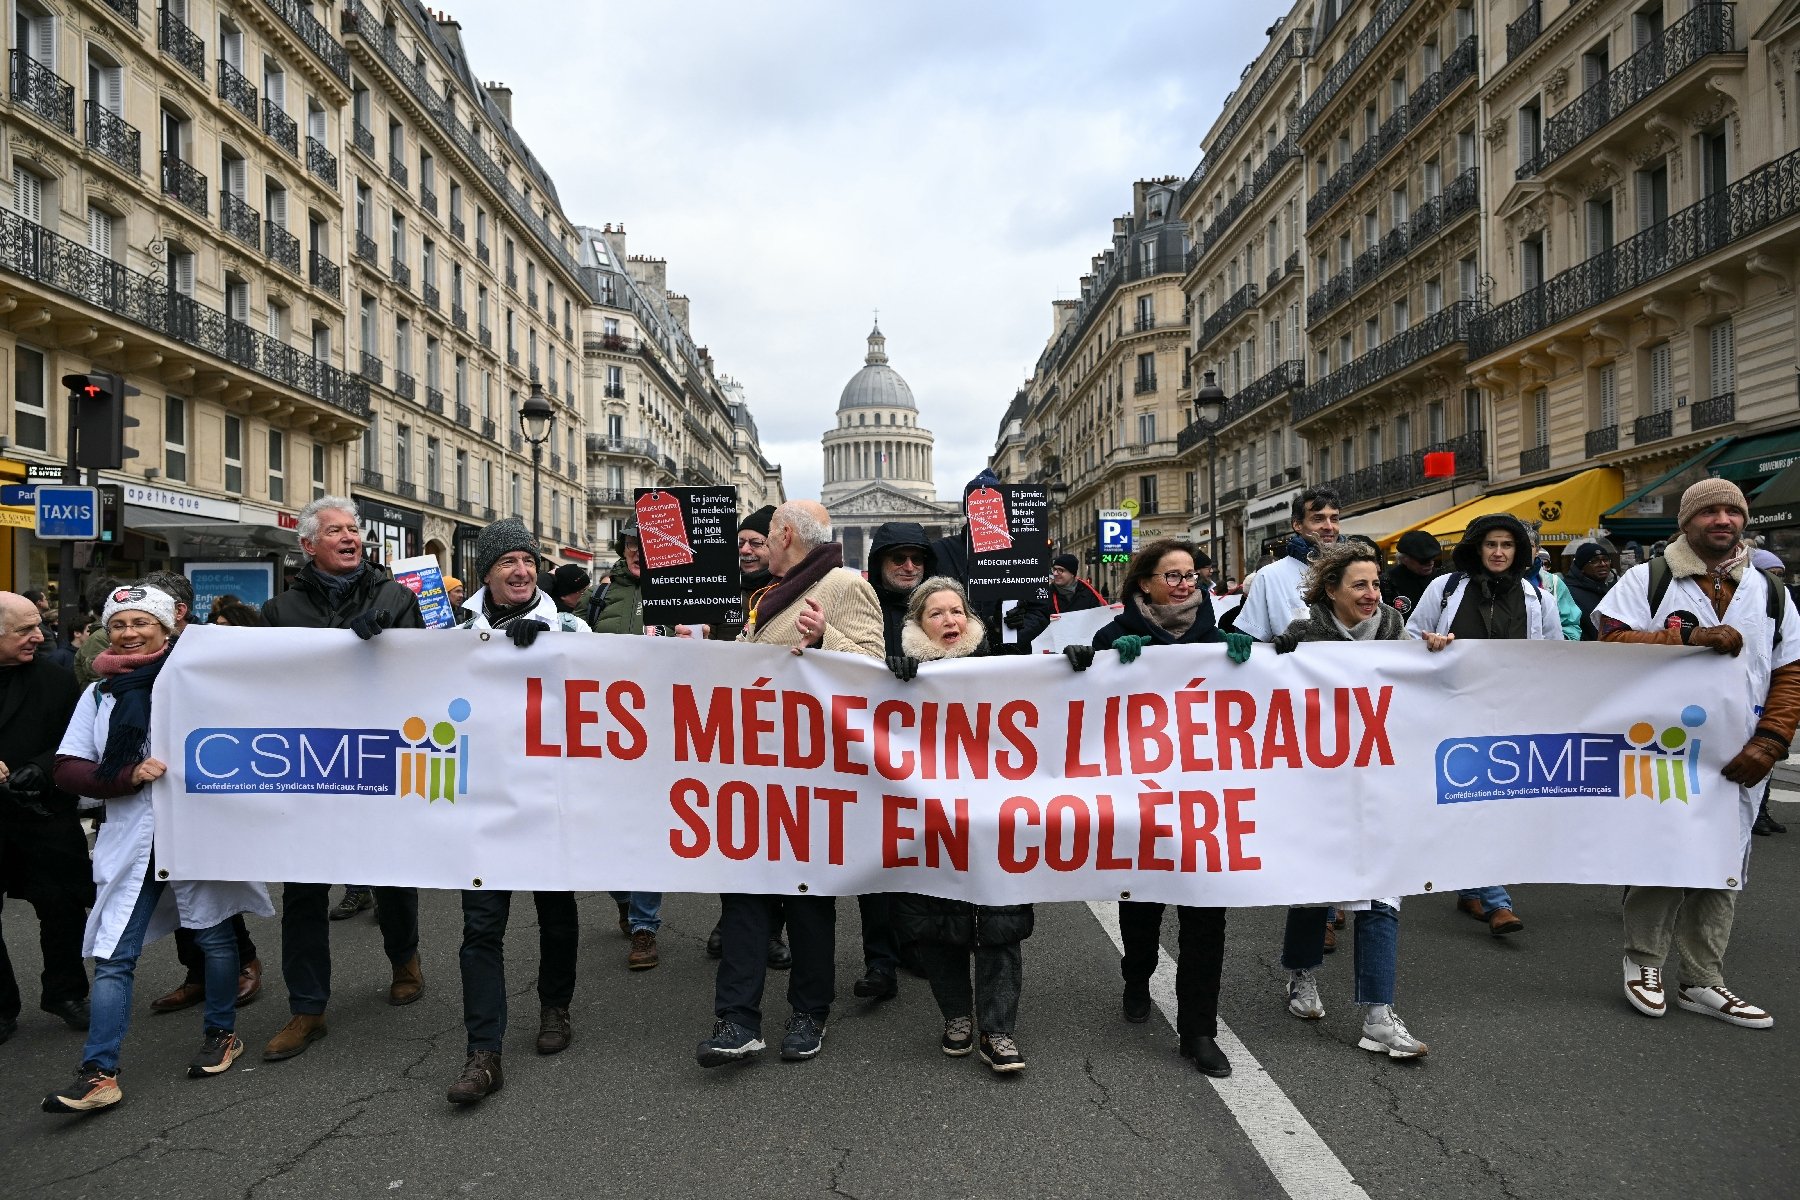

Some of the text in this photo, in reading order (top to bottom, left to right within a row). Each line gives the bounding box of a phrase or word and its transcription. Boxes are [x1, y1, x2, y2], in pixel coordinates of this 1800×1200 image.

[103, 497, 113, 505] 12
[691, 494, 733, 506] En janvier,
[42, 504, 91, 520] TAXIS
[700, 505, 736, 514] médecine
[1011, 508, 1035, 516] libérale
[692, 516, 720, 525] libérale
[692, 526, 722, 535] dit NON
[1103, 521, 1121, 544] P
[977, 557, 1039, 566] MÉDECINE BRADÉE
[651, 574, 728, 585] MÉDECINE BRADÉE
[1001, 576, 1049, 585] ABANDONNÉS
[642, 595, 741, 607] PATIENTS ABANDONNÉS
[526, 678, 1395, 781] LES MÉDECINS LIBÉRAUX
[195, 733, 390, 779] CSMF
[1443, 738, 1614, 788] CSMF
[195, 782, 389, 792] Confédération des Syndicats Médicaux Français
[1444, 789, 1491, 800] Confédération
[1506, 787, 1540, 797] Syndicats
[1541, 786, 1577, 795] Médicaux
[1579, 785, 1612, 795] Français
[670, 779, 1261, 874] SONT EN COLÈRE
